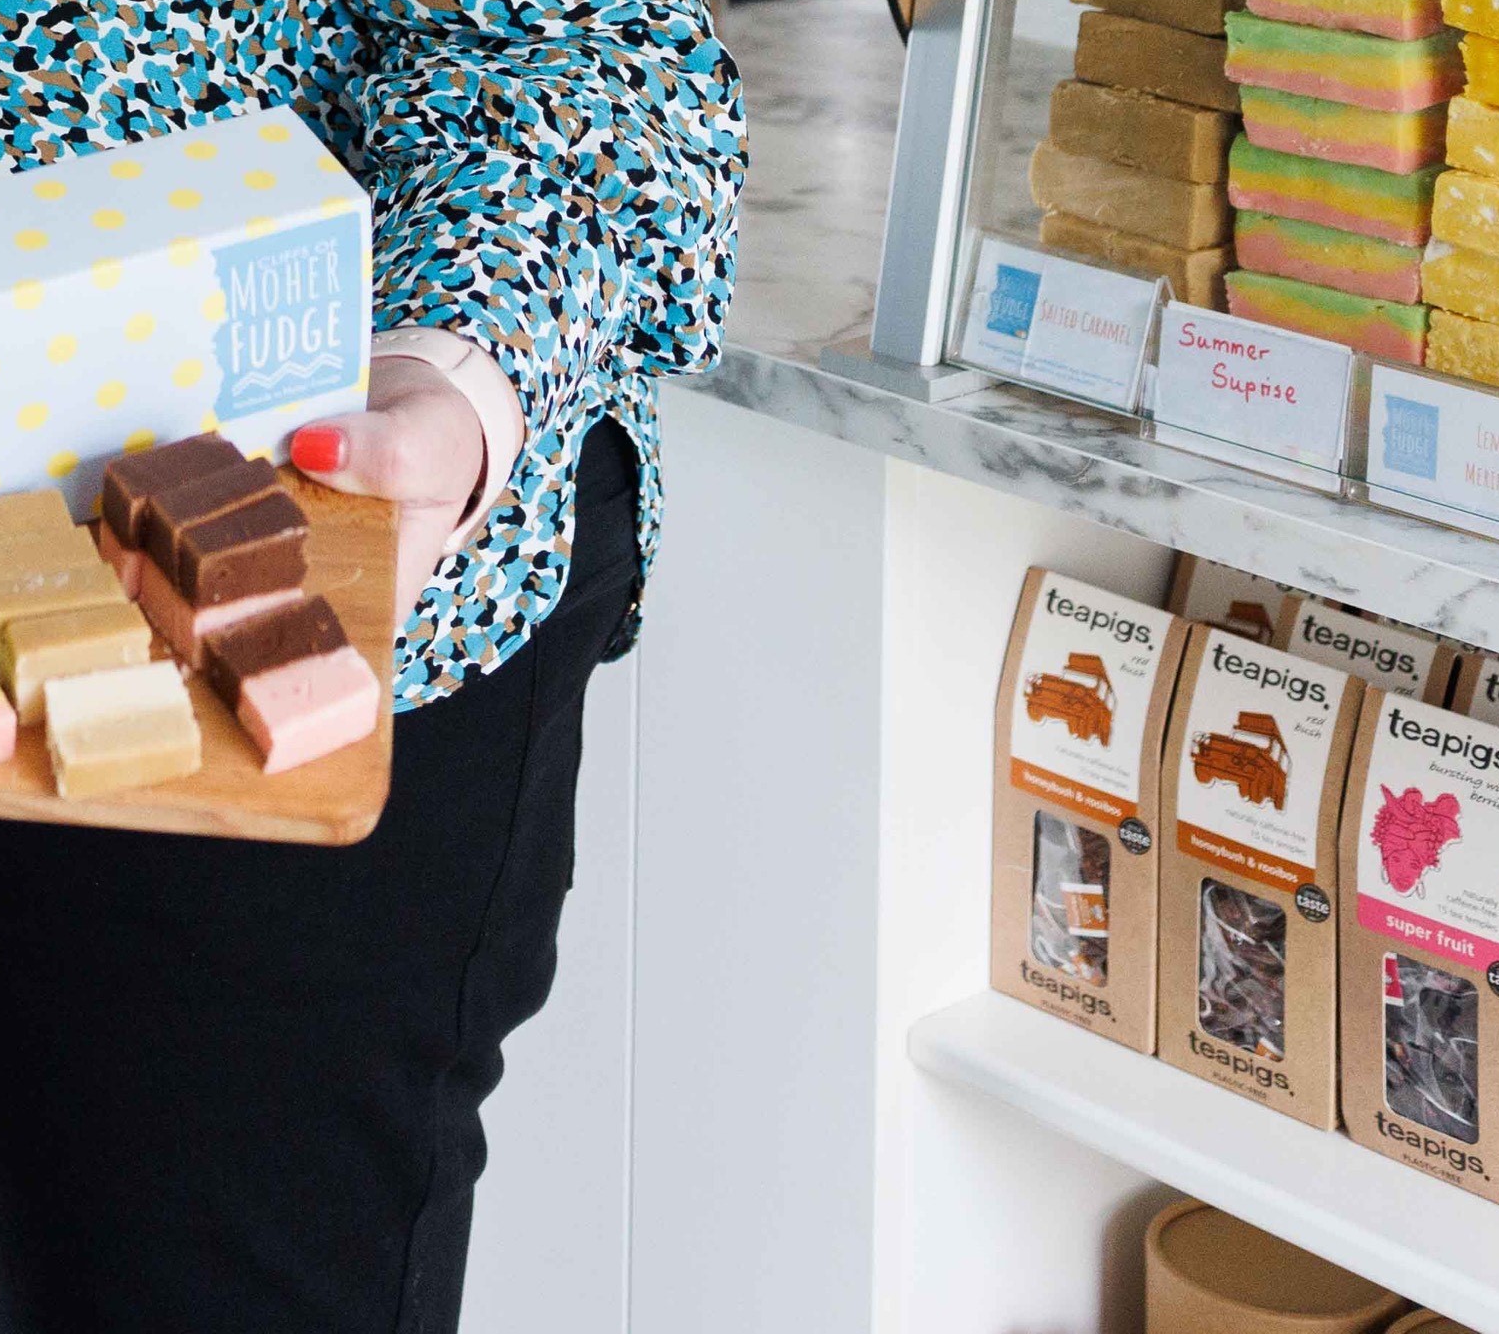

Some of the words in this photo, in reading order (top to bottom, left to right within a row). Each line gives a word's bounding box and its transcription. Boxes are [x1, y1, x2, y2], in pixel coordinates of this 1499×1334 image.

[230, 250, 341, 320] MOHER
[231, 300, 342, 375] FUDGE
[1178, 322, 1271, 361] Summer
[1211, 362, 1298, 405] Suprise
[1045, 587, 1155, 652] teapigs.
[1302, 613, 1420, 682] teapigs.
[1213, 643, 1331, 711] teapigs.
[1428, 761, 1485, 790] bursting
[1119, 827, 1151, 847] taste
[1246, 856, 1256, 869] &
[1296, 893, 1330, 915] taste
[1385, 913, 1432, 944] super
[1435, 929, 1476, 959] fruit
[1019, 959, 1117, 1024] teapigs.
[1188, 1030, 1295, 1098] teapigs.
[1373, 1110, 1491, 1182] teapigs.
